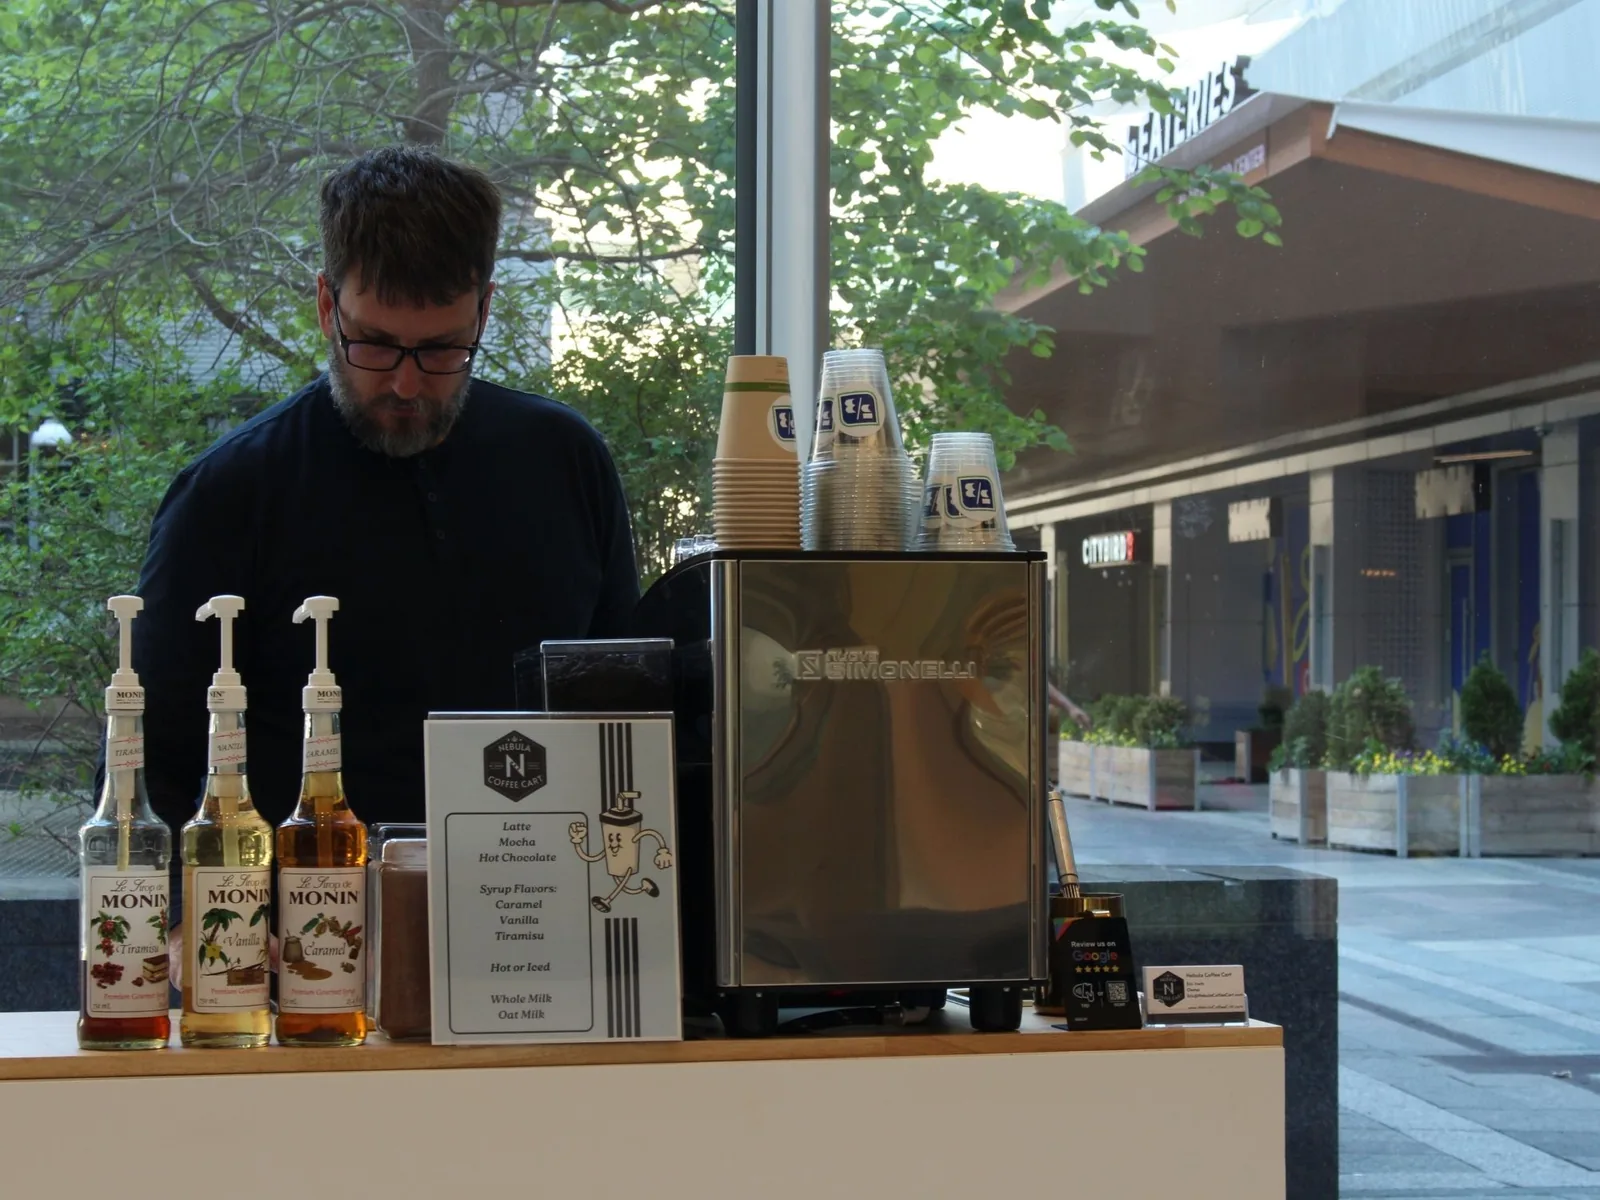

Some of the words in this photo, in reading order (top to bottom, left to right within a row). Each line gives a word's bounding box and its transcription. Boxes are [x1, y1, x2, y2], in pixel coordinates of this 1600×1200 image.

[825, 660, 977, 680] SIMONELLI
[498, 743, 531, 752] NEBULA
[487, 775, 519, 789] COFFEE
[520, 774, 543, 788] CART
[503, 821, 532, 831] Latte
[498, 837, 536, 847] Mocha
[479, 853, 500, 862] Hot
[501, 852, 557, 862] Chocolate
[110, 879, 128, 892] Le
[216, 874, 235, 888] Le
[296, 876, 312, 889] Le
[208, 888, 270, 904] MONIN
[480, 884, 512, 896] Syrup
[513, 884, 557, 894] Flavors:
[101, 893, 168, 909] MONIN
[289, 890, 359, 905] MONIN
[495, 899, 543, 909] Caramel
[499, 915, 540, 925] Vanilla
[223, 932, 260, 946] Vanilla
[495, 931, 545, 941] Tiramisu
[304, 940, 347, 956] Caramel
[1072, 950, 1118, 964] Google
[490, 963, 511, 973] Hot
[513, 964, 525, 972] or
[526, 962, 551, 972] Iced
[490, 995, 526, 1004] Whole
[527, 993, 553, 1003] Milk
[498, 1010, 519, 1020] Oat
[520, 1009, 545, 1019] Milk
